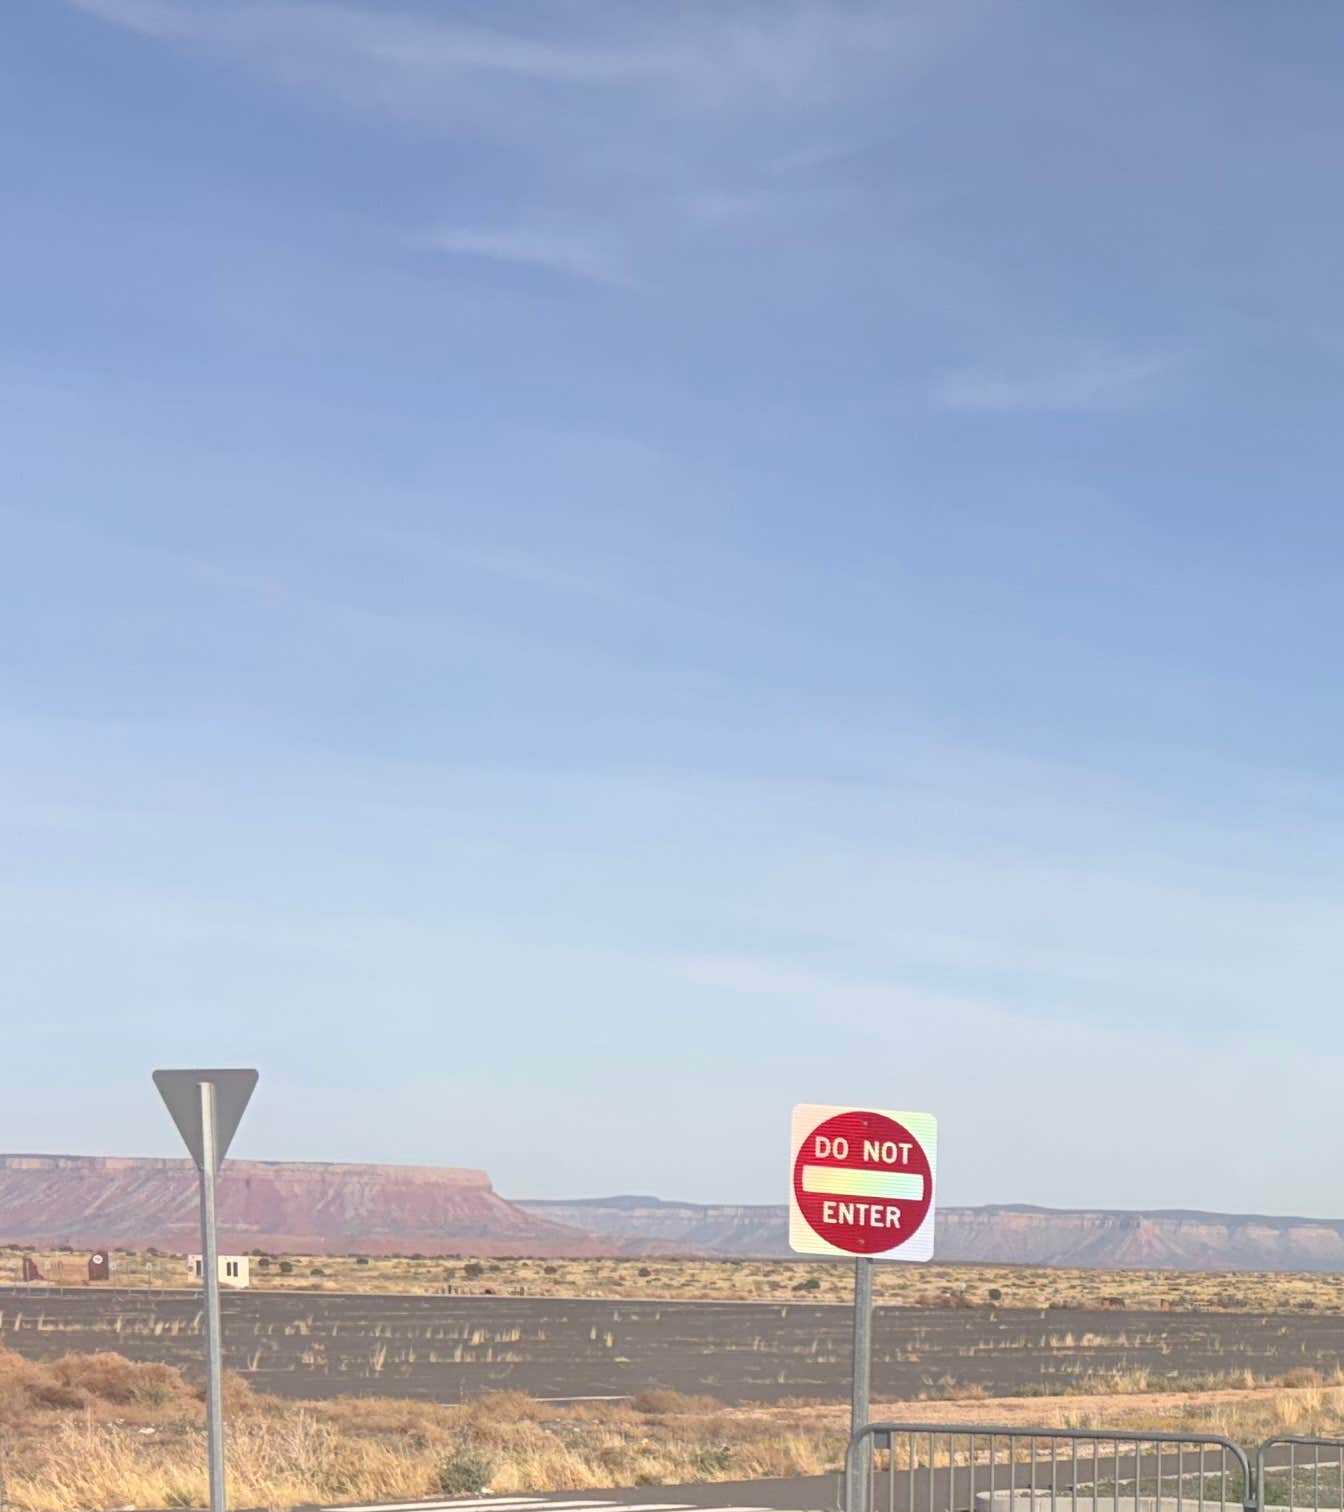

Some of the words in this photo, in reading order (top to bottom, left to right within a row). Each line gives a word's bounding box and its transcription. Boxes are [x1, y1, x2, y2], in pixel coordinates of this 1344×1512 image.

[815, 1136, 849, 1160] DO
[863, 1140, 913, 1165] NOT
[823, 1201, 901, 1229] ENTER
